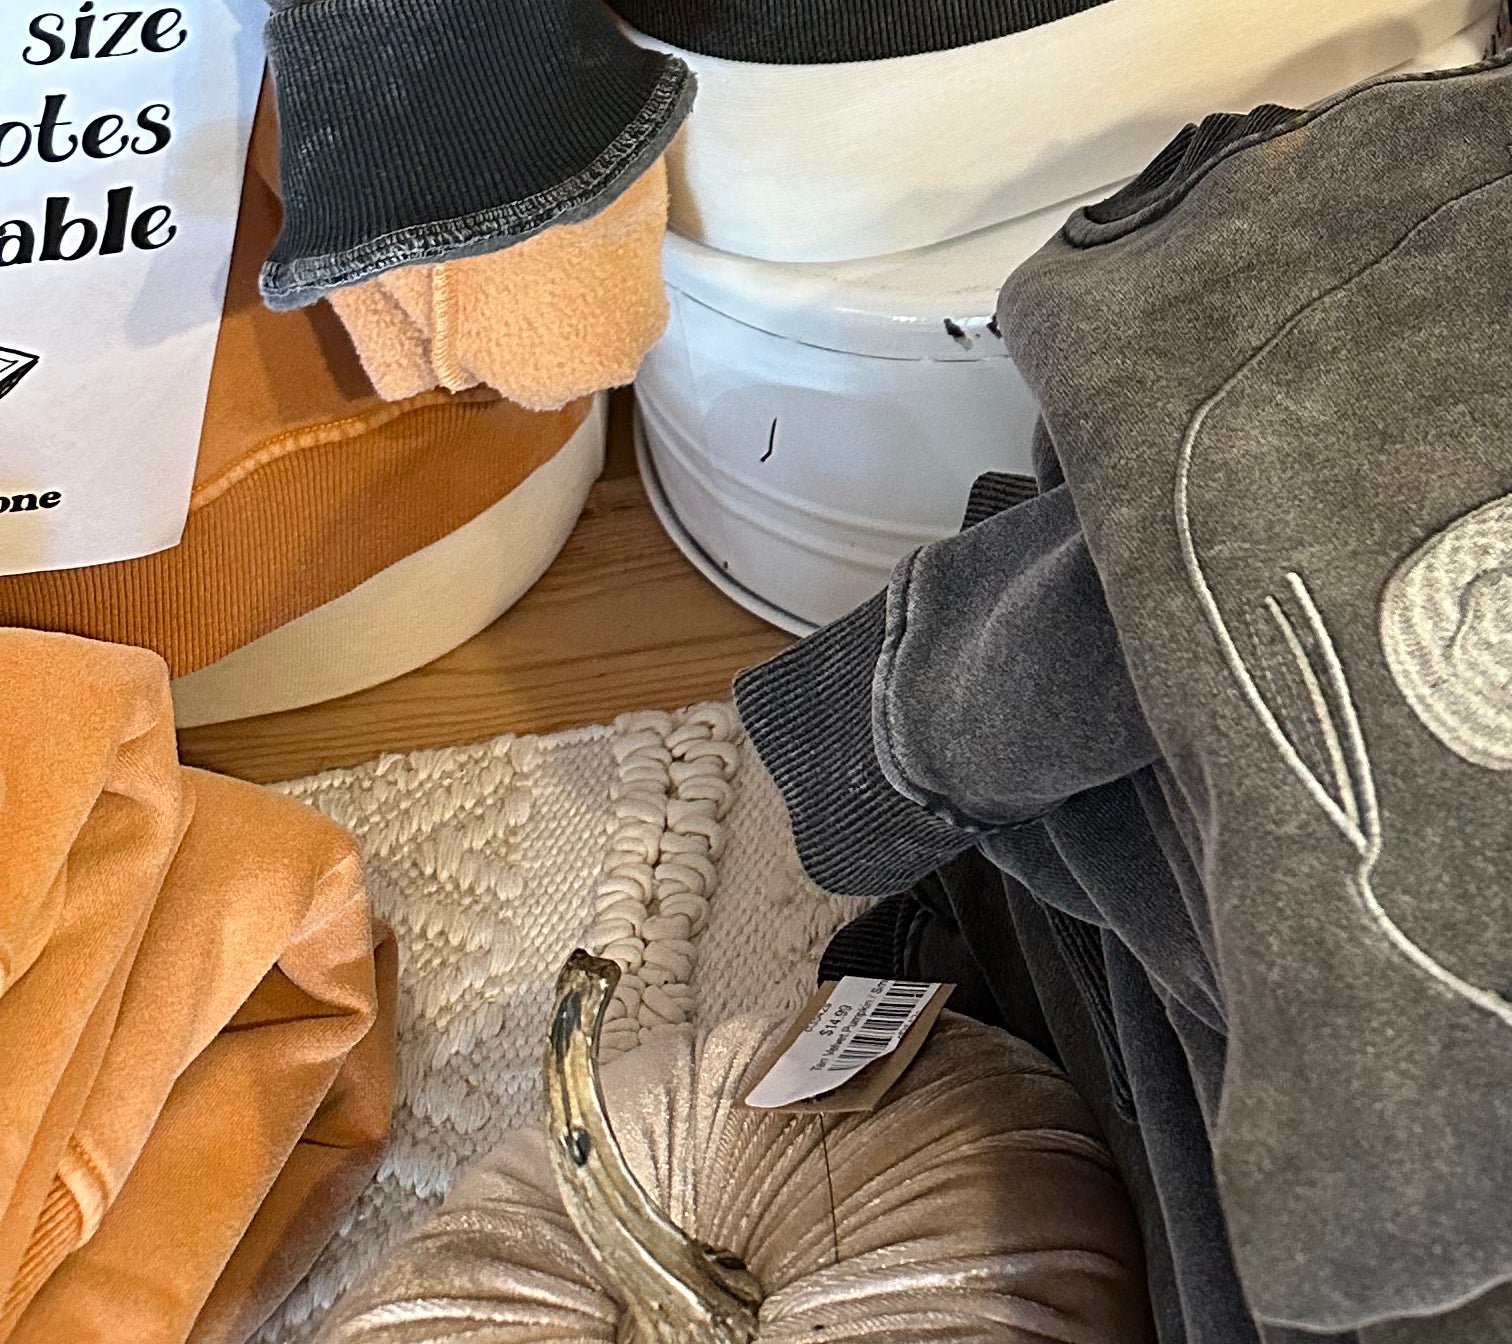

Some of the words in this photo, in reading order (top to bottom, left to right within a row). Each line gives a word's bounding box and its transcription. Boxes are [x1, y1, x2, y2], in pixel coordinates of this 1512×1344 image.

[22, 0, 188, 66] size
[0, 93, 173, 167] otes
[0, 186, 177, 268] able
[820, 1004, 853, 1037] $14.99
